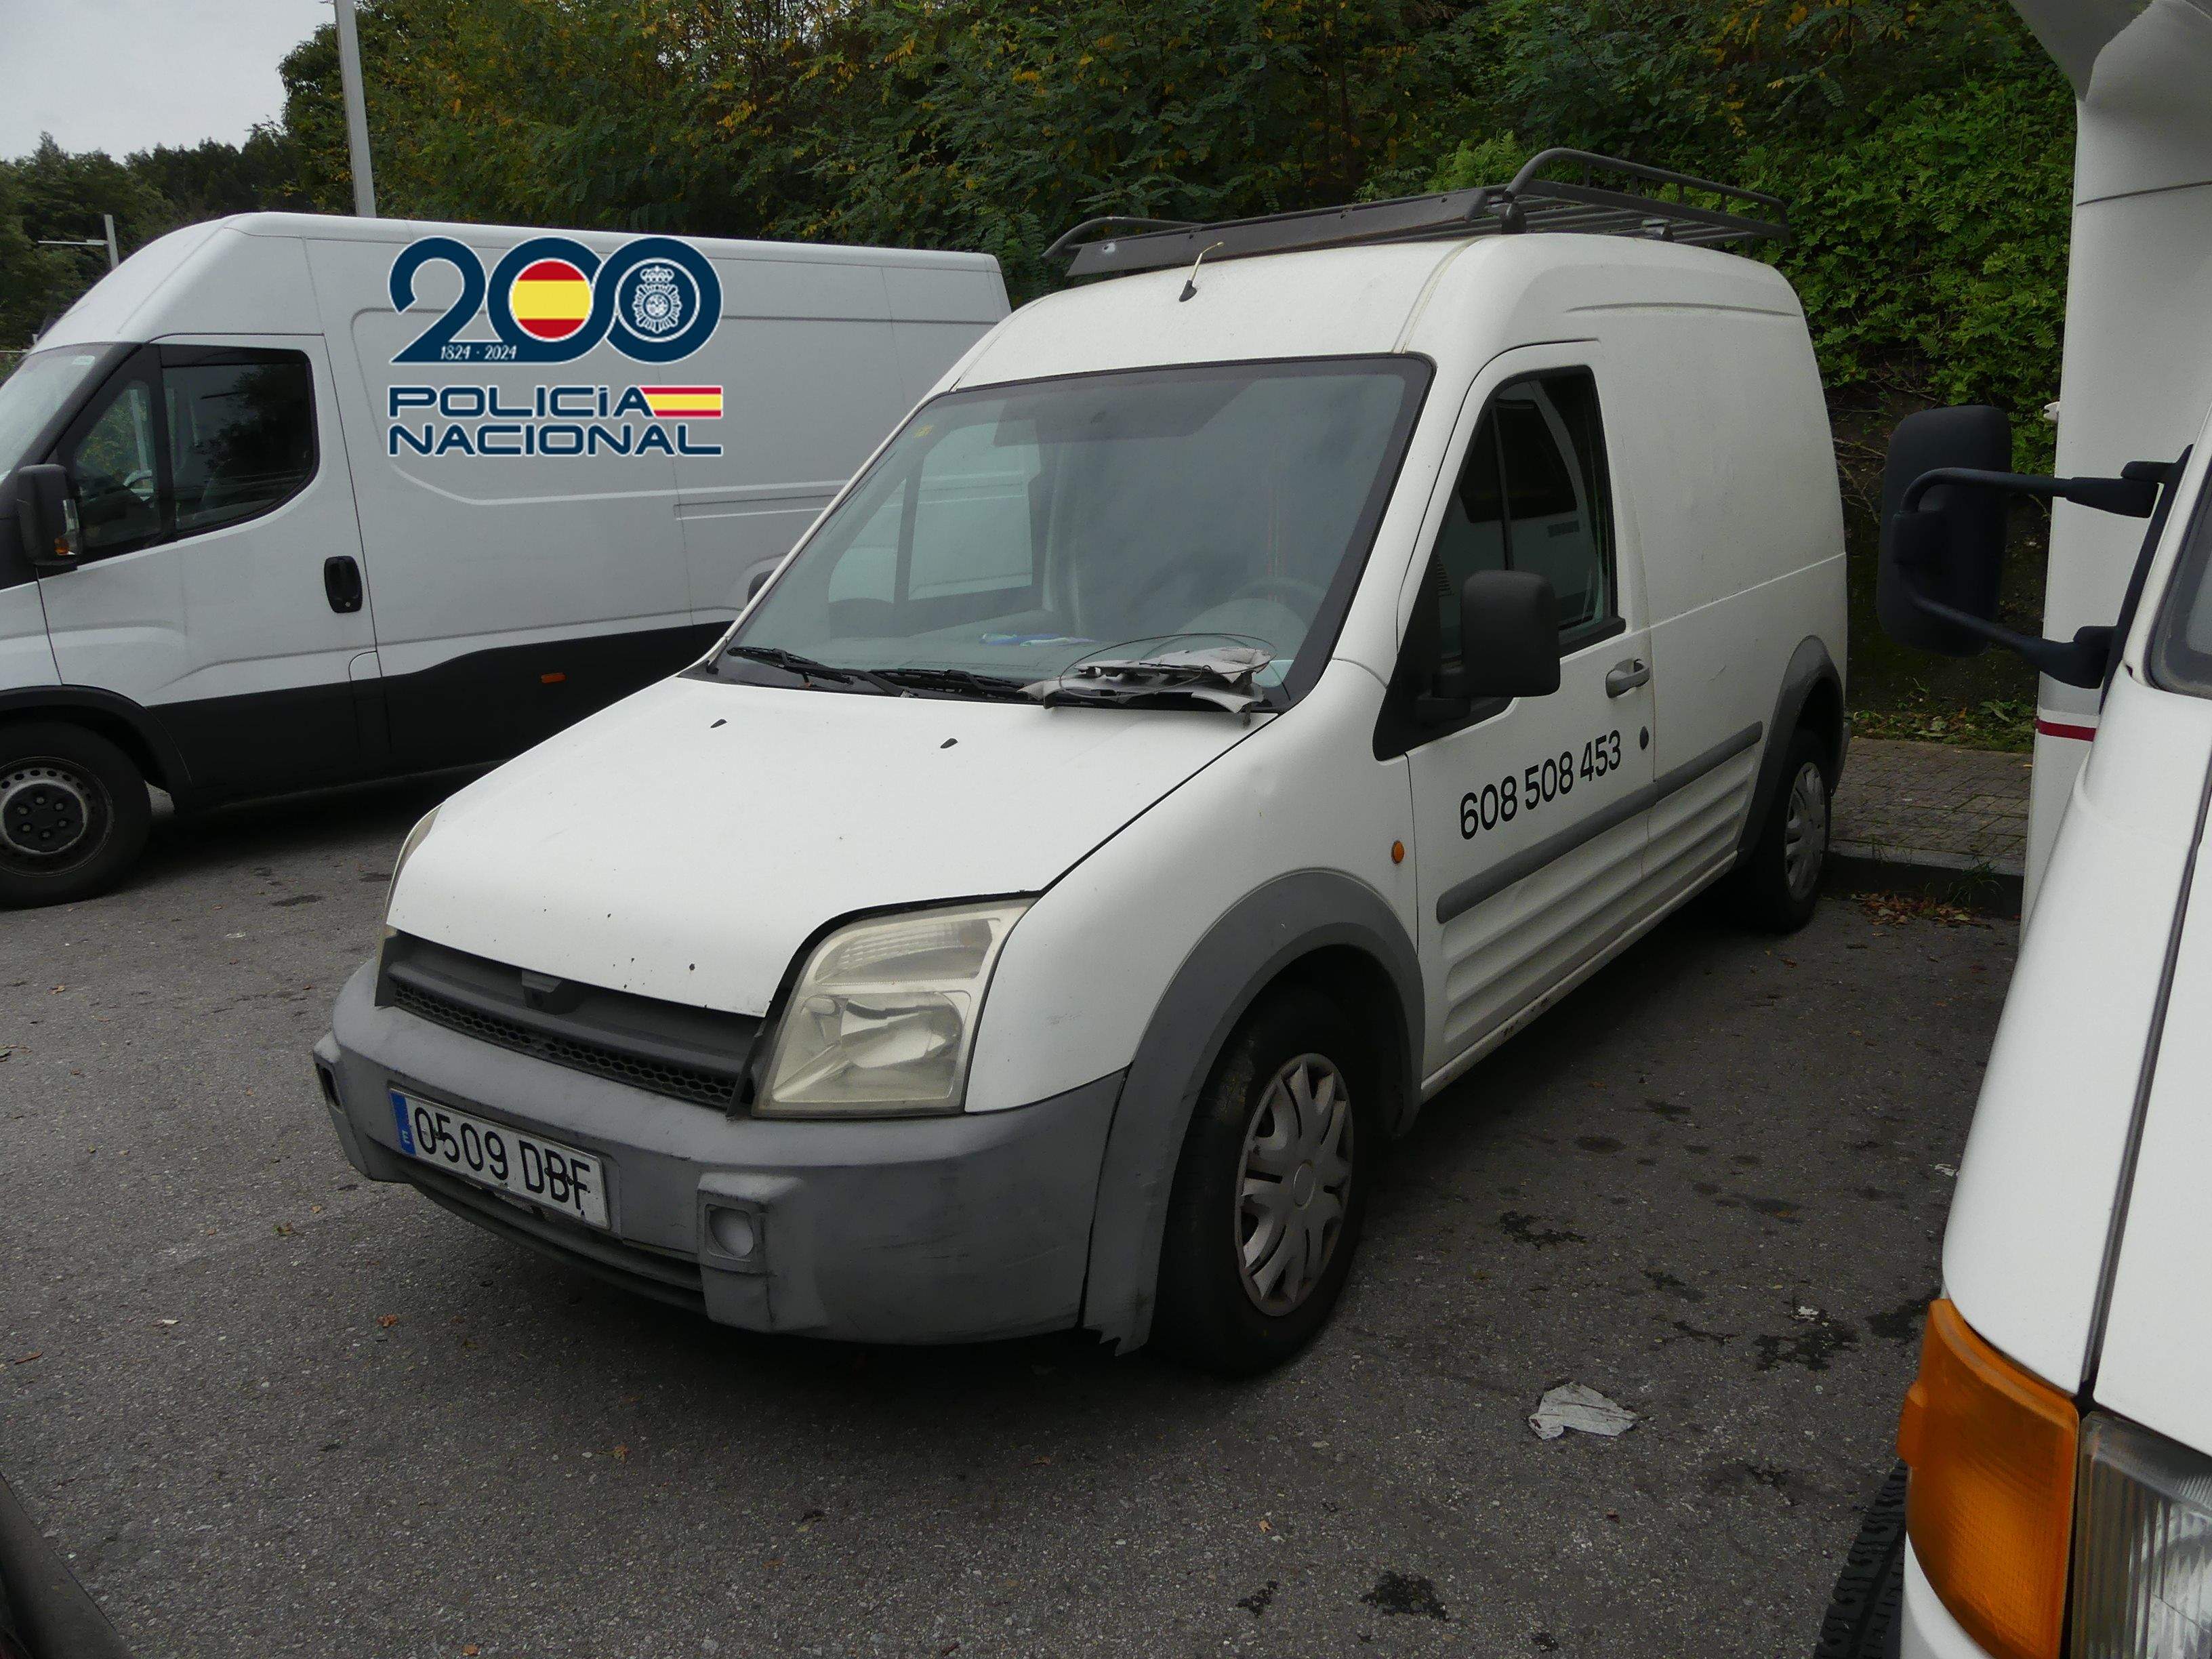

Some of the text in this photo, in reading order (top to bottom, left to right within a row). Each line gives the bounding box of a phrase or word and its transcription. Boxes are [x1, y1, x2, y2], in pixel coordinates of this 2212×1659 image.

[1460, 730, 1621, 840] 608 508 453
[414, 1107, 590, 1210] 0509 DBF
